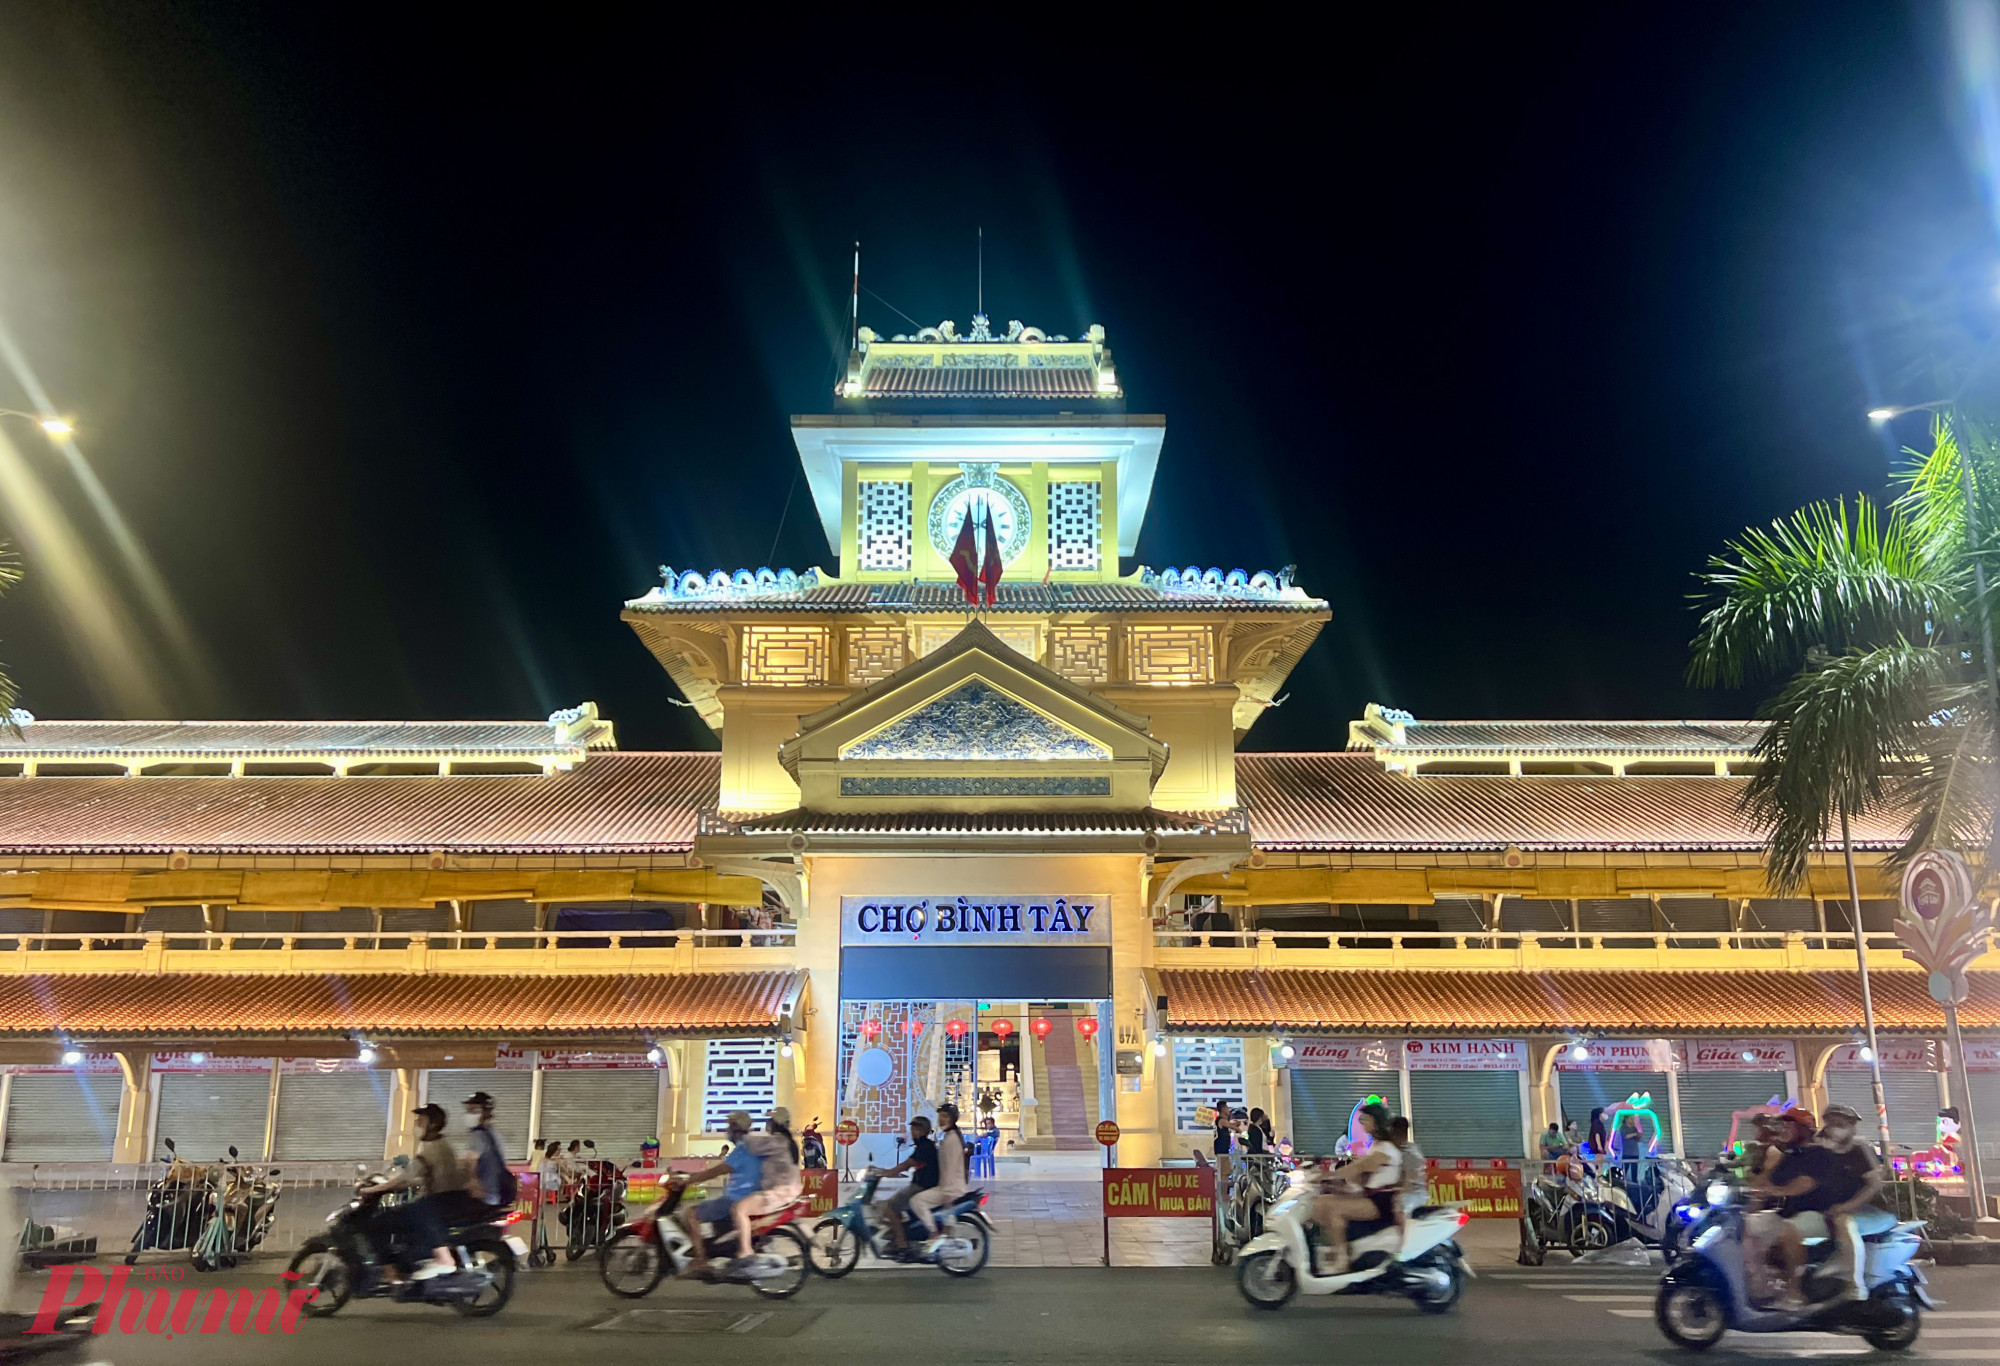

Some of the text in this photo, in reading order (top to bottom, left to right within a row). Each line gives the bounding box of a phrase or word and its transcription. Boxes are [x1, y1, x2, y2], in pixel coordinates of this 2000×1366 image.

[857, 896, 1095, 941] CHỢ BÌNH TÂY
[1429, 1042, 1515, 1057] KIM HẠNH
[1611, 1046, 1656, 1058] PHỤN
[808, 1176, 823, 1189] XE
[1107, 1174, 1149, 1206] CẤM
[1159, 1172, 1199, 1191] ĐẬU XE
[1491, 1175, 1507, 1189] XE
[1427, 1176, 1456, 1206] ẤM
[810, 1196, 834, 1212] BÁN
[1160, 1195, 1212, 1212] MUA BÁN
[1467, 1195, 1519, 1212] MUA BÁN
